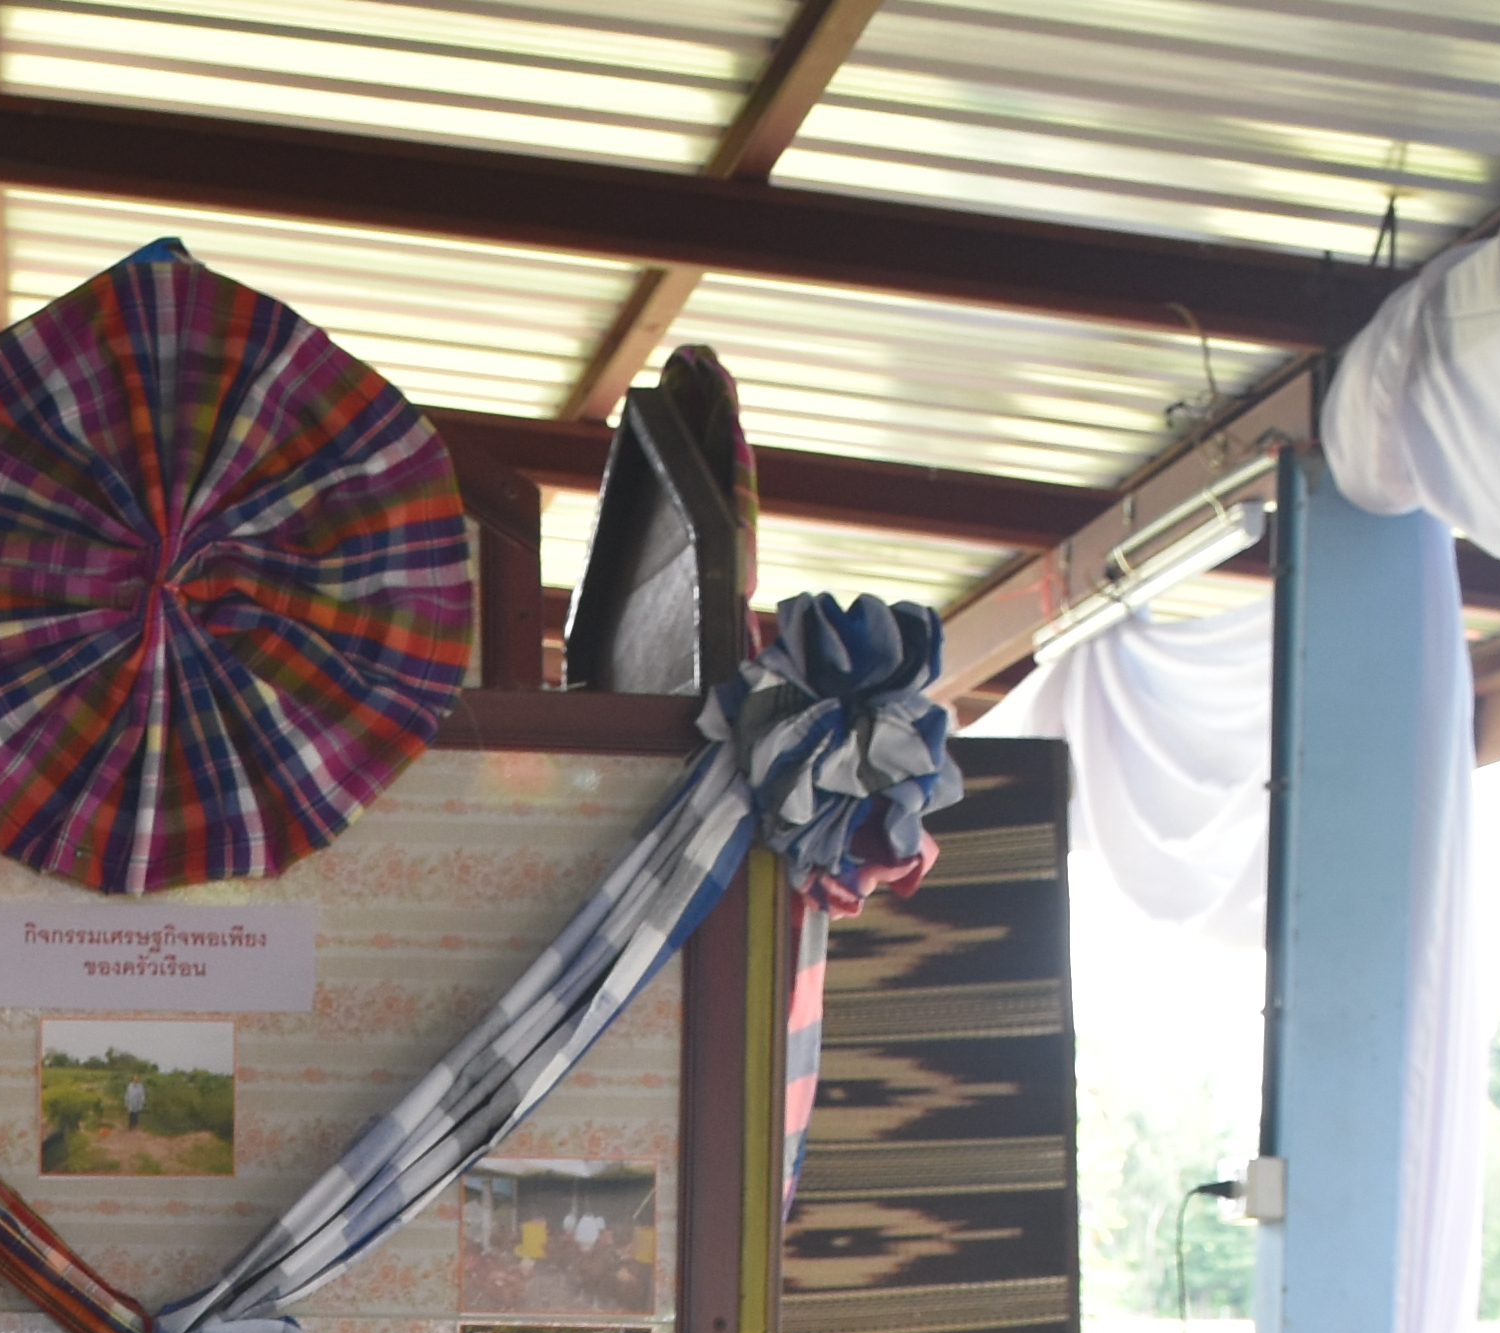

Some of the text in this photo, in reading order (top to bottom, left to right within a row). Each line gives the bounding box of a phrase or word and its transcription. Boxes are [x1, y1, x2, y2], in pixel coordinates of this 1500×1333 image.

[24, 921, 267, 953] กิจกรรมเศรษฐกิจพอเพียง
[84, 953, 207, 977] ของครัวเรือน
